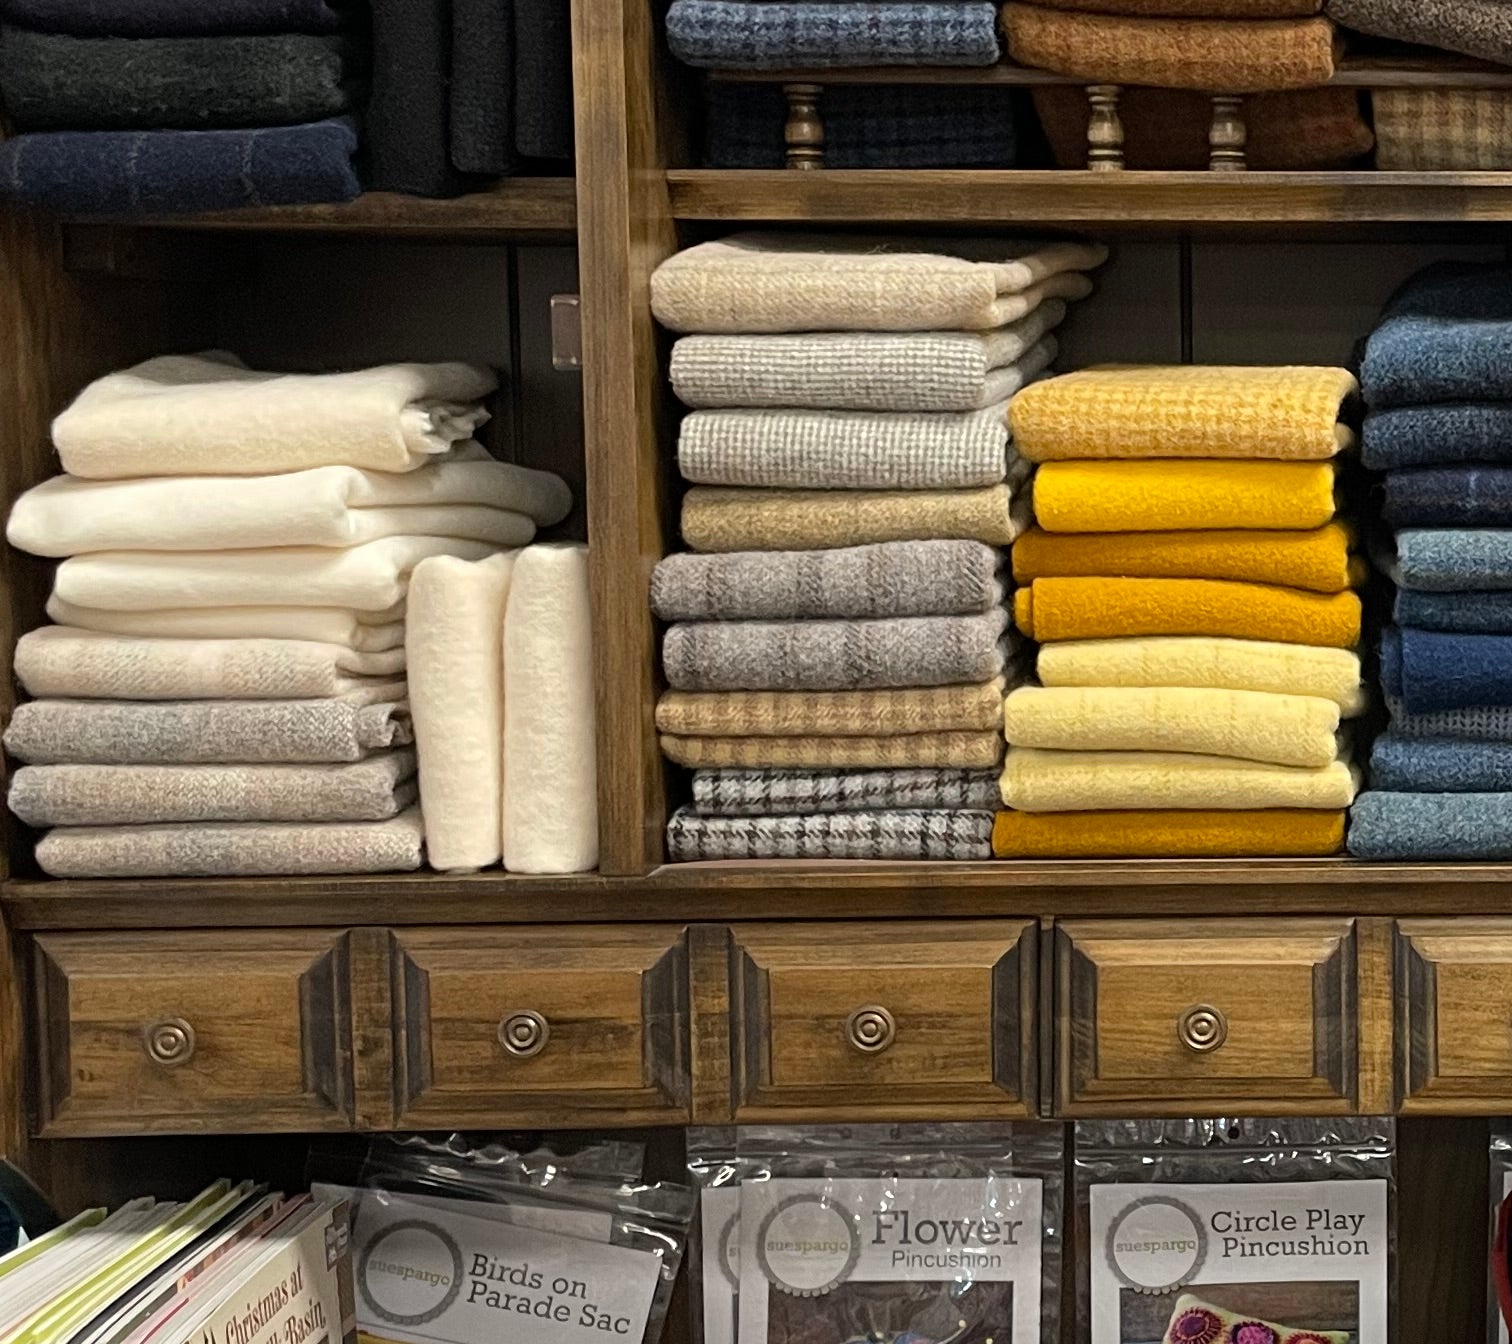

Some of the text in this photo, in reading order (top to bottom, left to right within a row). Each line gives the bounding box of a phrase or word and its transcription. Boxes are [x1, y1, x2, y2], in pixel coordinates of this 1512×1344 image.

[871, 1210, 1023, 1246] Flower
[1211, 1209, 1366, 1235] Circle Play
[766, 1239, 849, 1255] suespargo
[891, 1249, 1002, 1269] Pincushion
[1115, 1239, 1197, 1254] suespargo
[1222, 1235, 1370, 1257] Pincushion
[290, 1261, 304, 1297] at
[368, 1259, 450, 1287] suespargo
[468, 1253, 587, 1299] Birds on
[467, 1281, 631, 1334] Parade Sac
